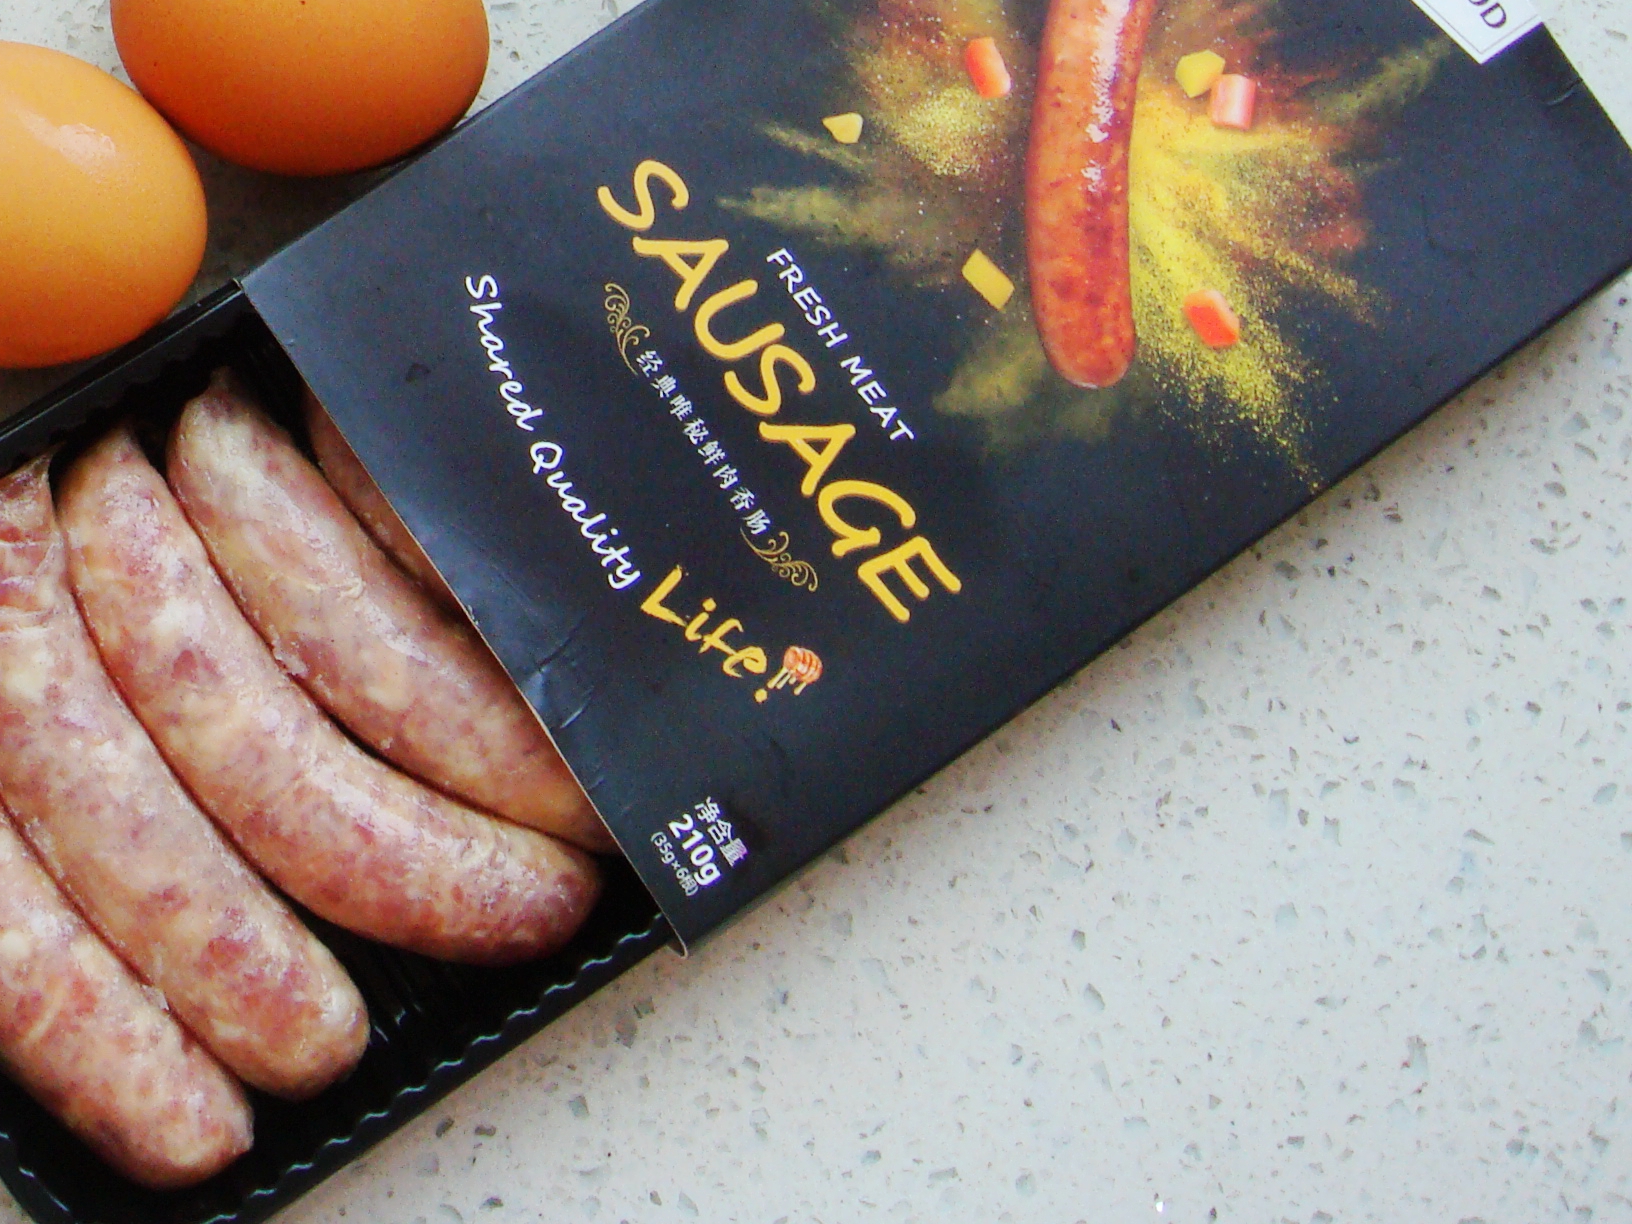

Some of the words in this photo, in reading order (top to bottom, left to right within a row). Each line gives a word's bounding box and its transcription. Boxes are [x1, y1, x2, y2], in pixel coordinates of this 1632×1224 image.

[465, 274, 544, 433] Shared
[529, 441, 642, 590] Quality
[597, 159, 962, 624] SAUSAGE
[766, 247, 849, 349] FRESH
[840, 355, 916, 444] MEAT
[669, 813, 721, 886] 210g
[694, 796, 748, 867] 净含量
